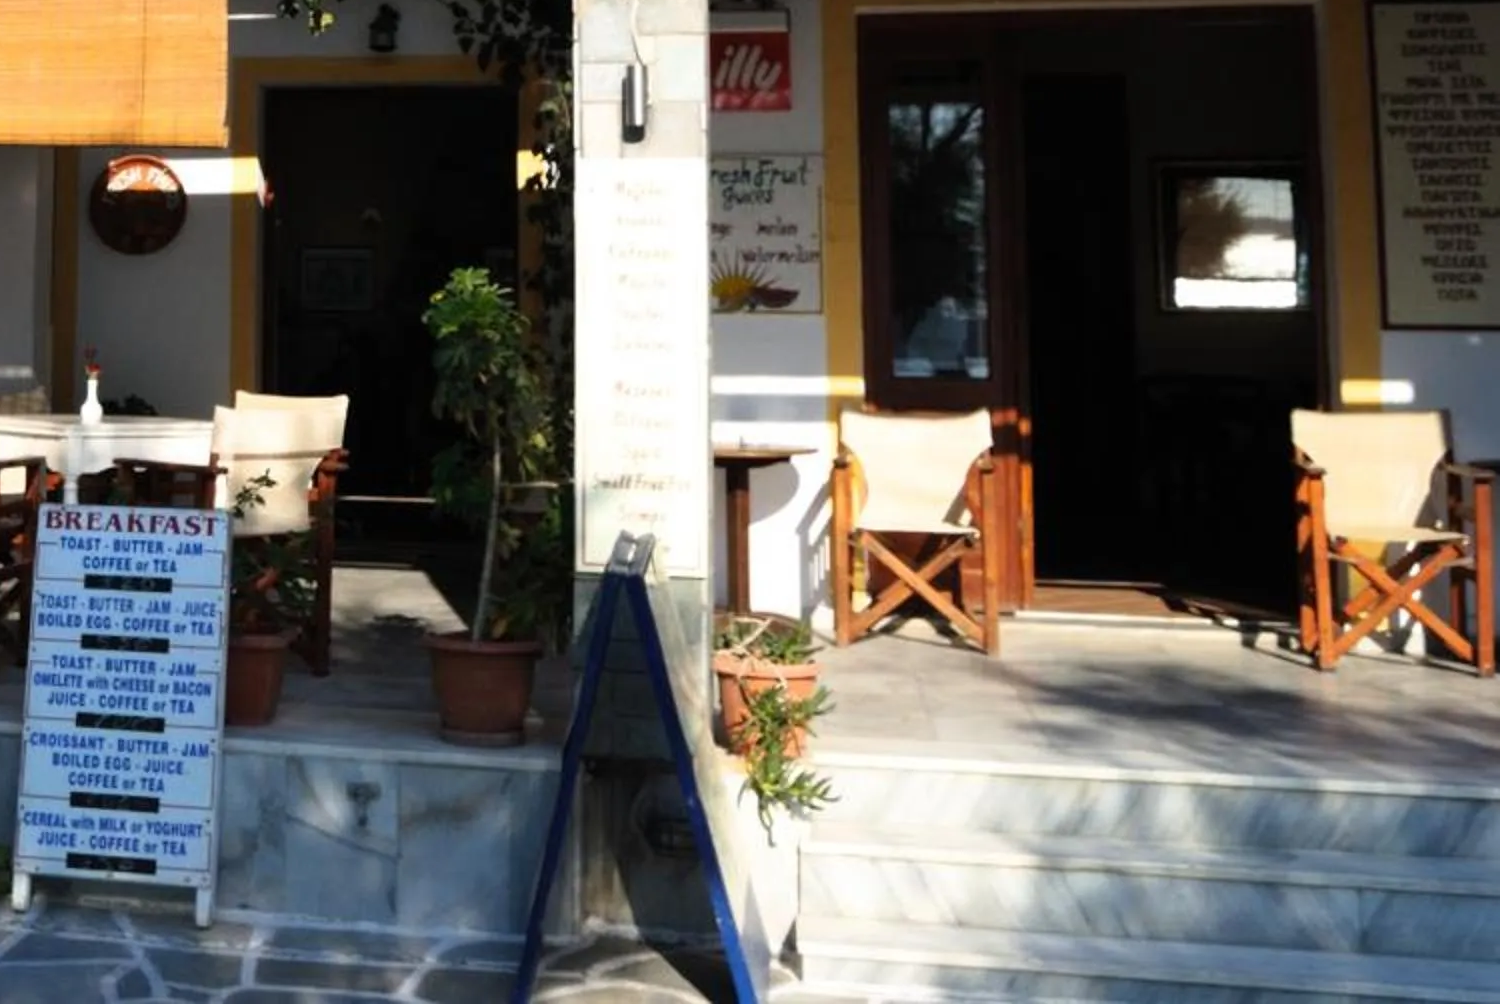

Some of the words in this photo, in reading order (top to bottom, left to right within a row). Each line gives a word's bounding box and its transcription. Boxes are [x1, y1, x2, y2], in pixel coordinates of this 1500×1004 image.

[714, 44, 783, 93] illy
[711, 156, 751, 185] resh
[45, 511, 218, 536] BREAKFAST
[61, 536, 100, 551] TOAST
[113, 539, 164, 553] BUTTER
[176, 543, 203, 556] JAM
[83, 556, 132, 570] COFFEE
[135, 561, 149, 571] or
[153, 559, 177, 573] TEA
[40, 595, 76, 609] TOAST
[89, 597, 134, 612] BUTTER
[146, 601, 171, 614] JAM
[183, 602, 216, 617] JUICE
[38, 614, 82, 628] BOILED
[86, 616, 112, 630] EGG
[123, 618, 170, 634] COFFEE
[173, 623, 187, 634] or
[190, 621, 214, 636] TEA
[51, 655, 93, 670] TOAST
[105, 658, 156, 674] BUTTER
[168, 662, 196, 677] JAM
[34, 672, 82, 689] OMELETE
[87, 675, 109, 690] with
[112, 676, 155, 693] CHEESE
[157, 682, 170, 694] or
[173, 680, 212, 696] BACON
[47, 692, 86, 707] JUICE
[99, 695, 148, 711] COFFEE
[152, 700, 166, 712] or
[171, 699, 195, 714] TEA
[30, 732, 106, 750] CROISSANT
[117, 738, 169, 755] BUTTER
[182, 743, 210, 757] JAM
[52, 752, 100, 768] BOILED
[104, 757, 131, 772] EGG
[143, 759, 184, 775] JUICE
[68, 772, 118, 789] COFFEE
[122, 778, 136, 789] or
[141, 777, 165, 793] TEA
[23, 811, 67, 828] CEREAL
[71, 813, 95, 829] with
[98, 817, 127, 833] MILK
[130, 822, 143, 833] or
[146, 821, 203, 838] YOGHURT
[37, 831, 77, 846] JUICE
[89, 835, 140, 853] COFFEE
[144, 843, 157, 854] or
[162, 840, 187, 857] TEA
